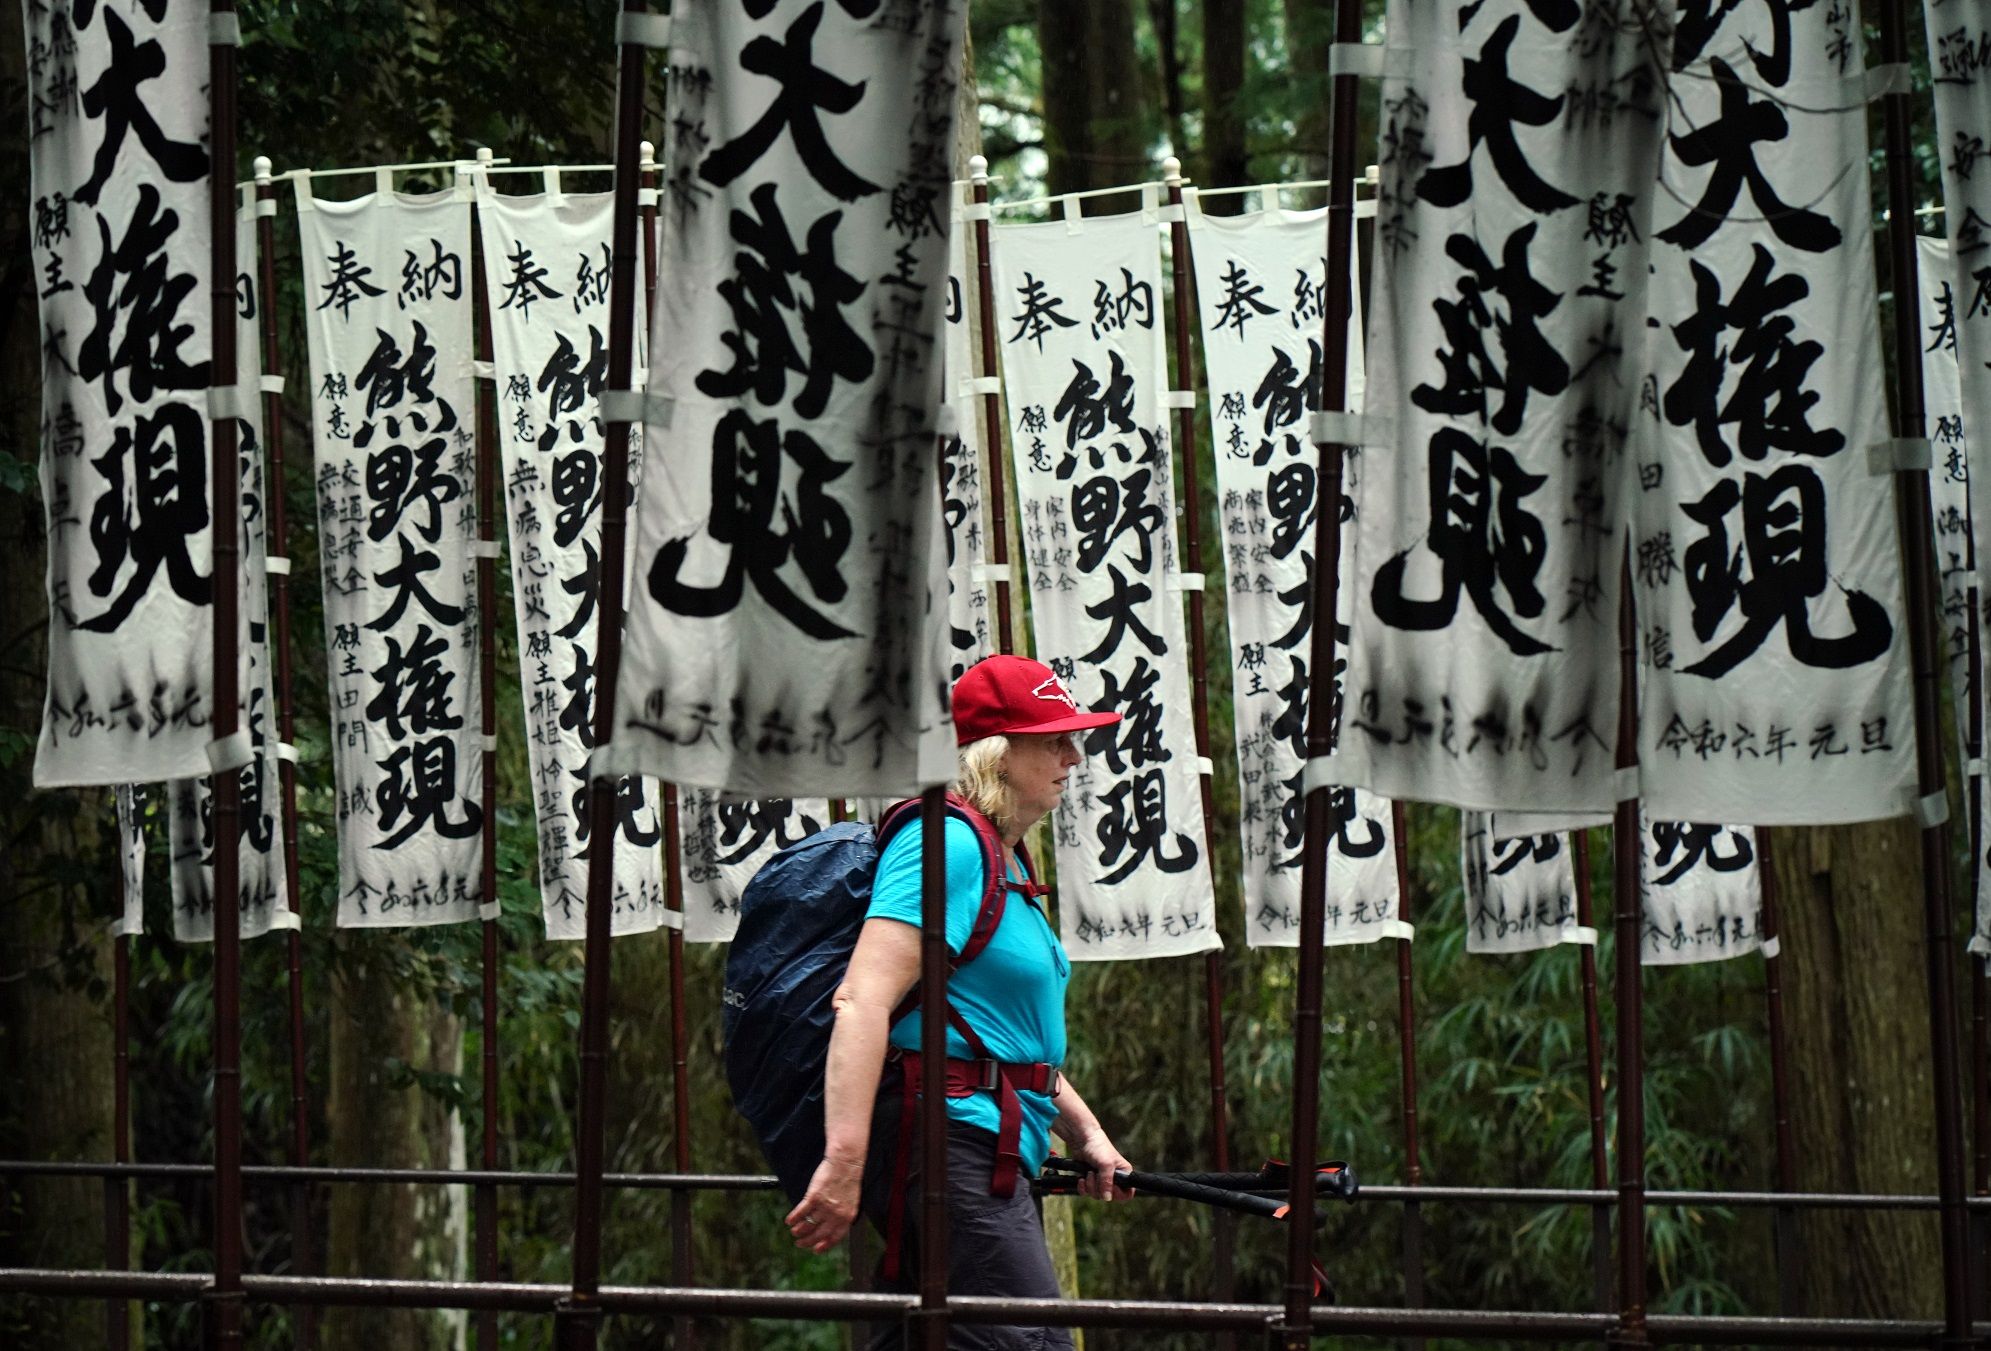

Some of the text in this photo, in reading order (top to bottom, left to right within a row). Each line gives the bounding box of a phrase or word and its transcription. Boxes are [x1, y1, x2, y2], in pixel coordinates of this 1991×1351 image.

[34, 192, 74, 300] 願主
[317, 238, 462, 323] 奉納
[72, 0, 212, 633] 大権現
[1008, 267, 1155, 355] 奉納
[318, 372, 350, 440] 願意
[1016, 404, 1053, 473] 願意
[1217, 392, 1249, 460] 願意
[1933, 416, 1969, 484] 願意
[339, 457, 367, 595] 交通安全
[504, 373, 554, 623] 願意 無病息災
[1023, 497, 1055, 592] 身体健全
[1046, 494, 1077, 592] 家内安全
[1223, 488, 1253, 594] 商売繁盛
[1246, 488, 1276, 594] 家内安全
[353, 319, 483, 850] 熊野大権現
[1053, 349, 1198, 886] 熊野大権現
[332, 623, 364, 677] 願主
[525, 631, 556, 686] 願主
[1238, 643, 1269, 696] 願主
[50, 680, 245, 748] 令和六年元
[1656, 712, 1894, 765] 令和六年元旦
[346, 870, 482, 915] 令和六年元
[1255, 899, 1391, 933] 令和年元旦
[1641, 911, 1763, 952] 令和六年元
